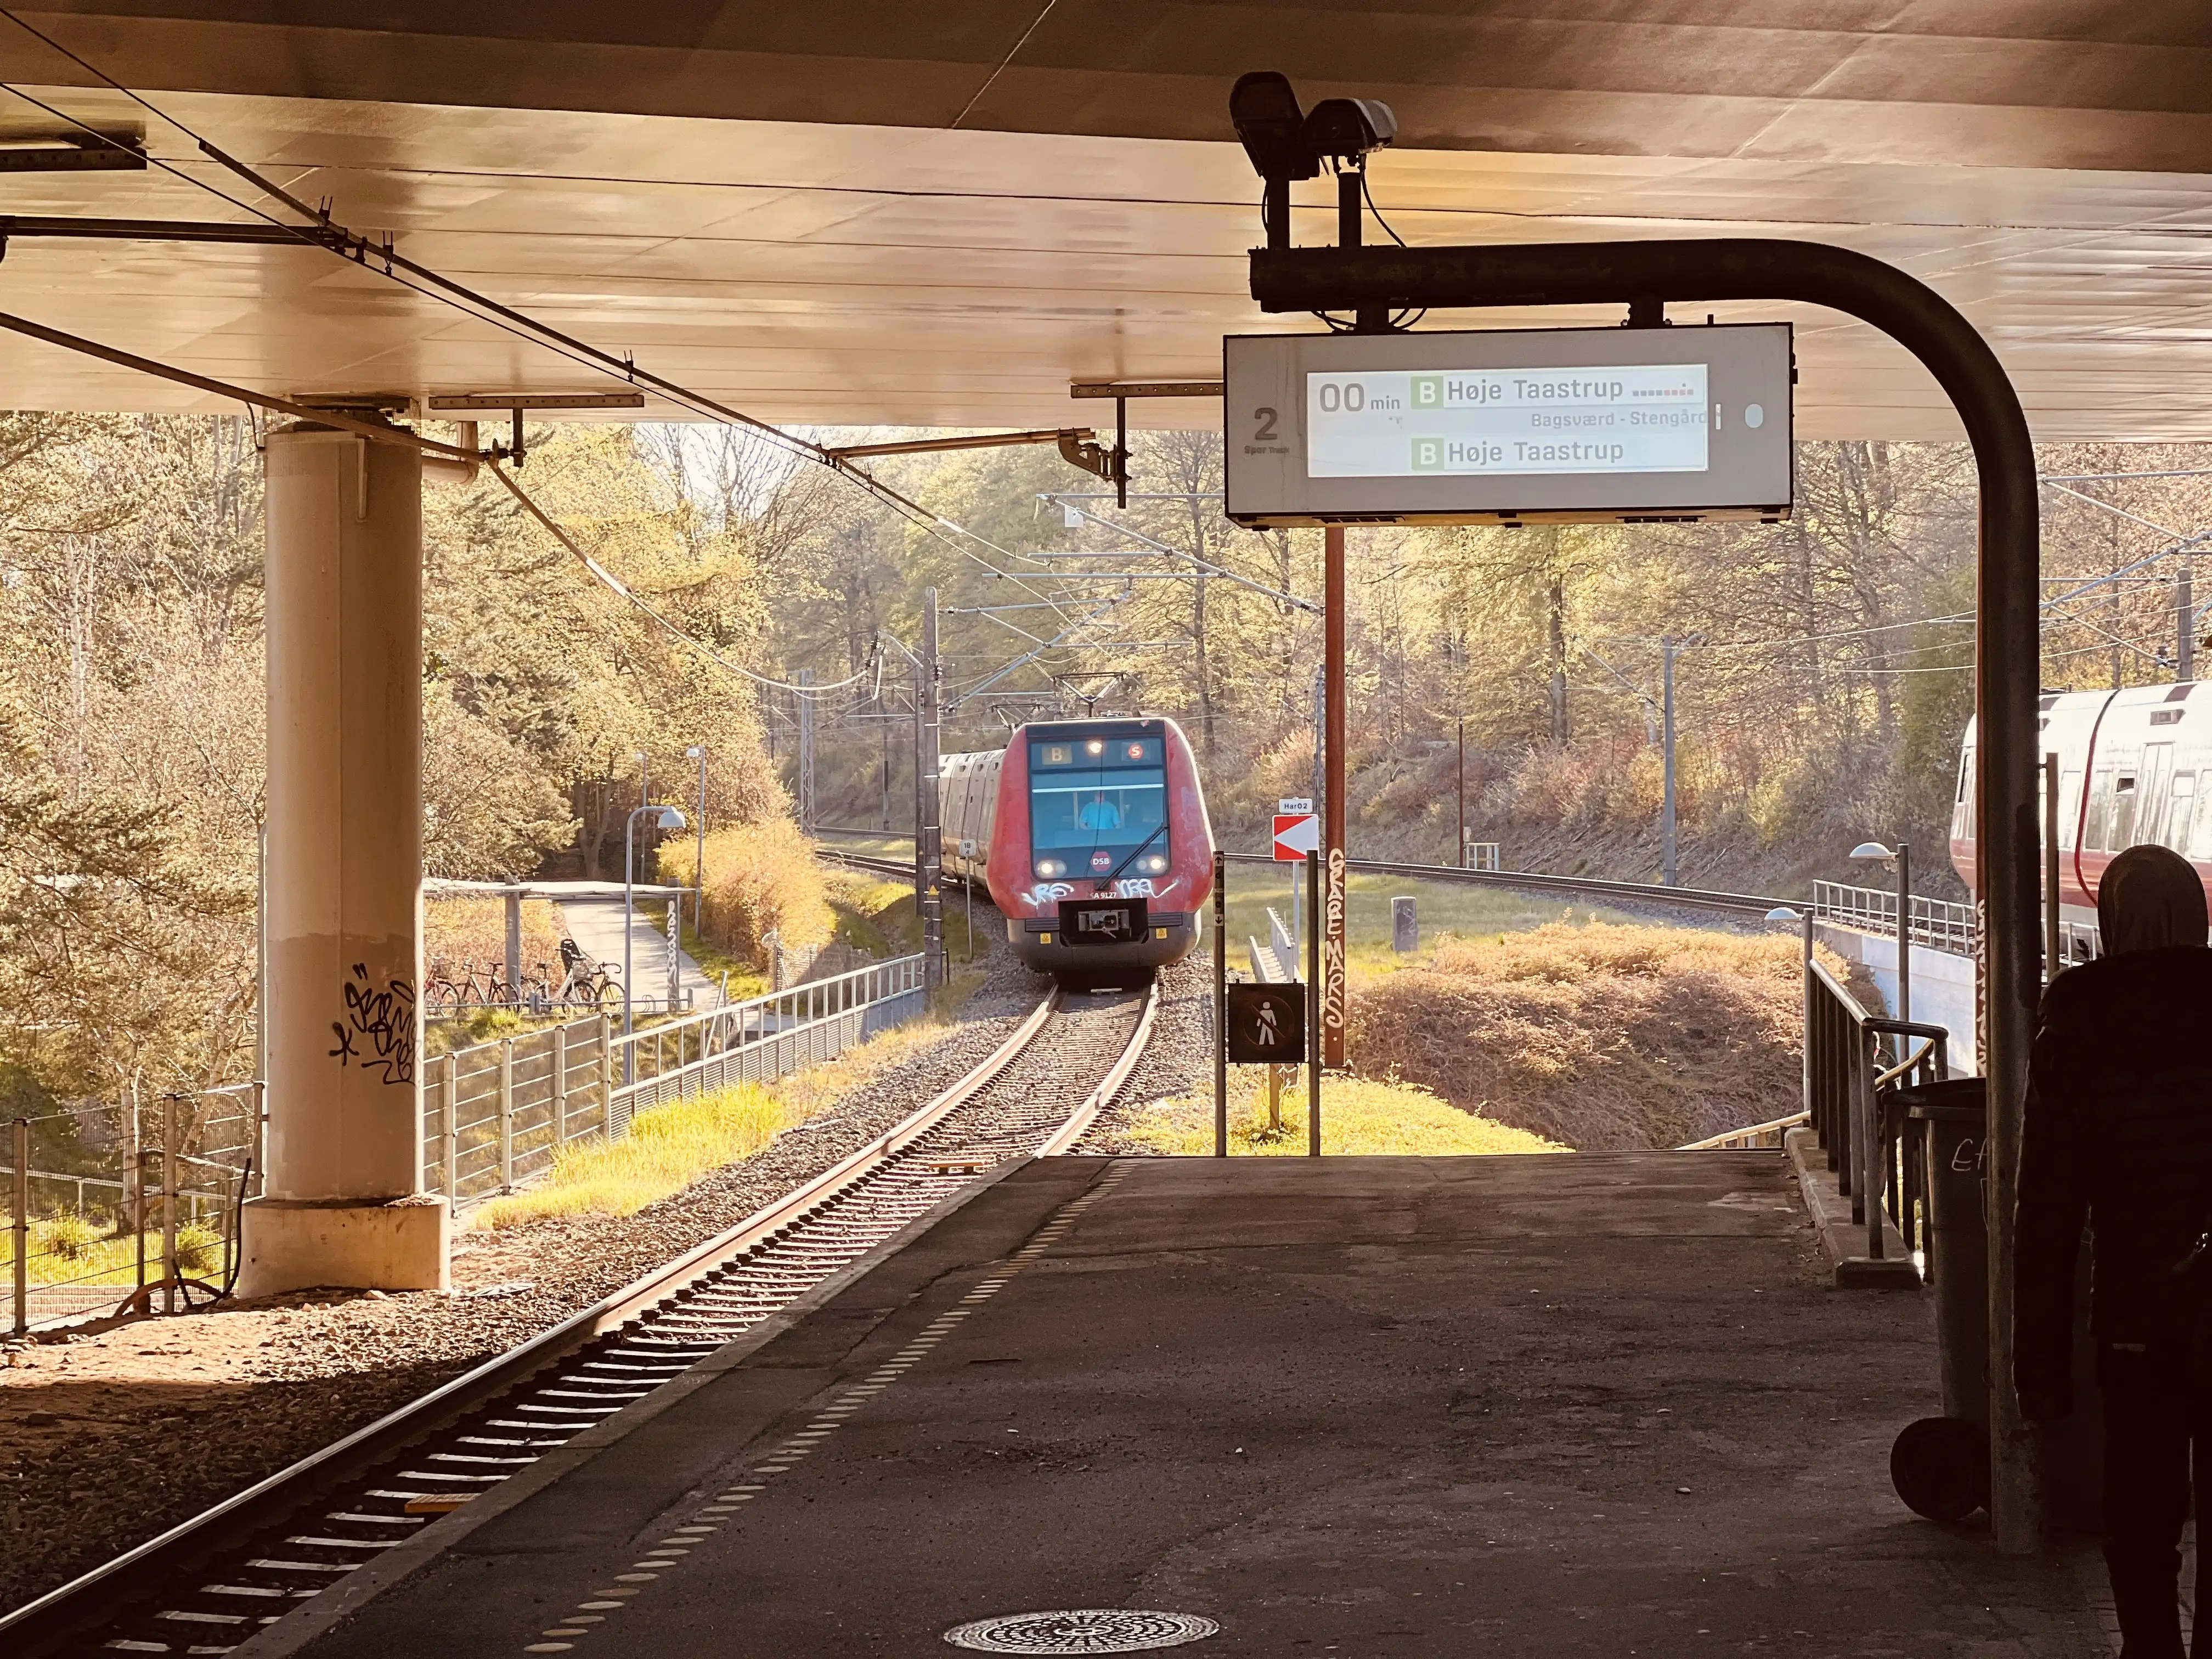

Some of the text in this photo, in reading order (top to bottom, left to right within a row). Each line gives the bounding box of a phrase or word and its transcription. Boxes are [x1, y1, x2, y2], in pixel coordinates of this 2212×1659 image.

[1319, 383, 1401, 412] 00 min
[1419, 379, 1623, 404] B Høje Taastrup
[1254, 407, 1278, 440] 2
[1531, 412, 1615, 429] Bagsværd
[1420, 441, 1624, 466] B Høje Taastrup
[1051, 747, 1063, 761] B
